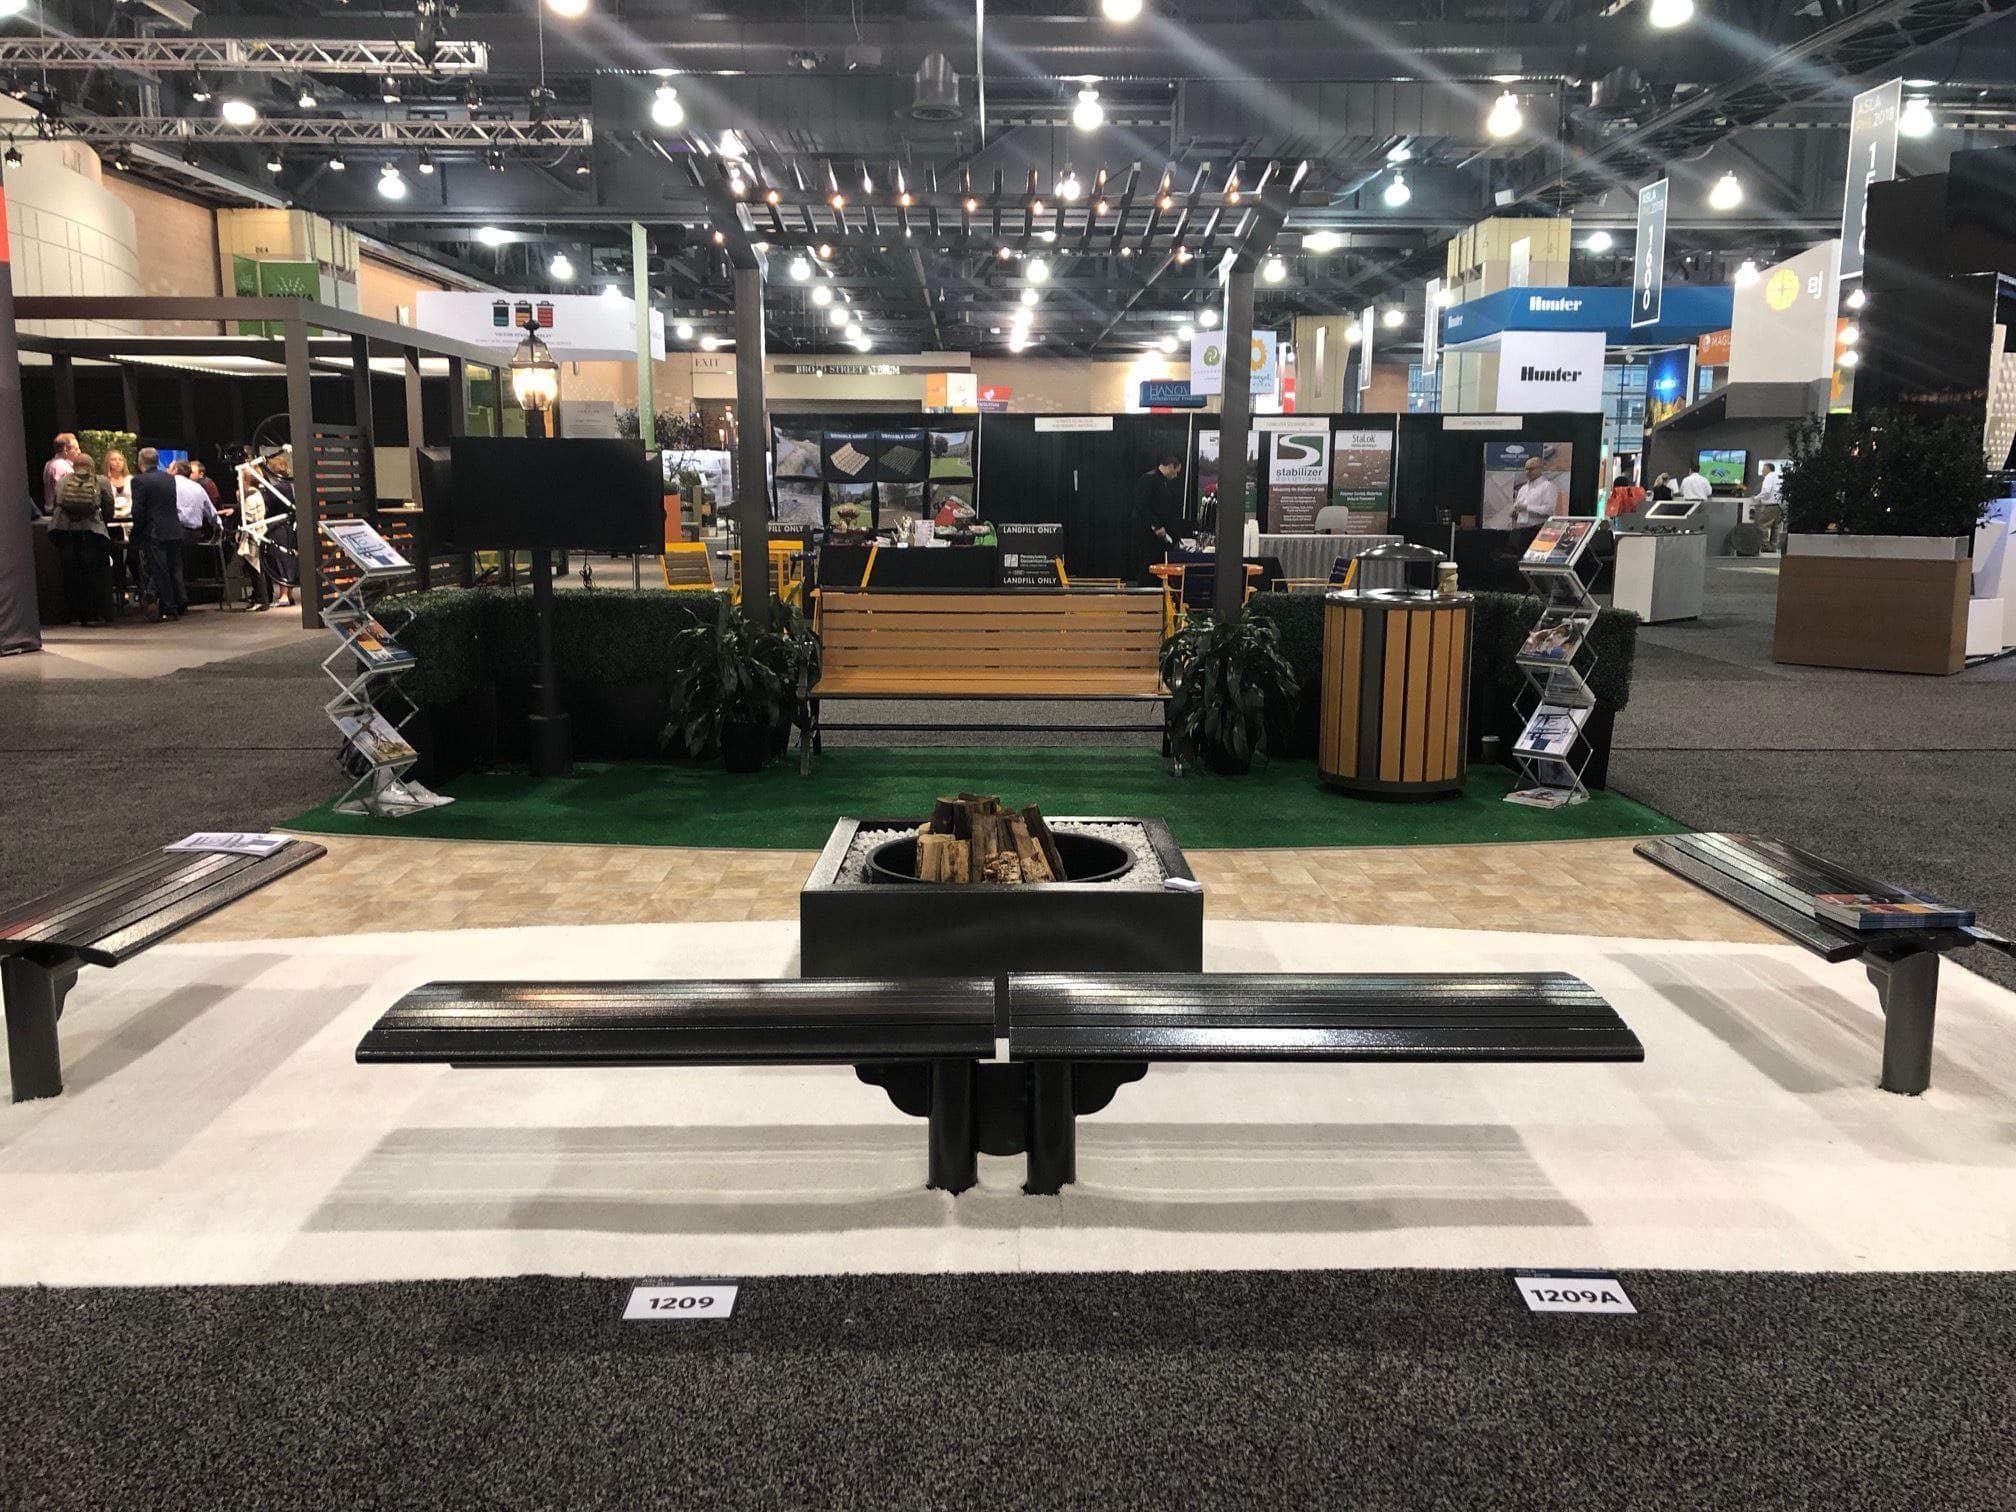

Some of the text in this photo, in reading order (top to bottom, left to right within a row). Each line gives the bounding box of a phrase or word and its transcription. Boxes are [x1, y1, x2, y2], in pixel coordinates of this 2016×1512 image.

[1643, 224, 1653, 311] 1600
[1529, 295, 1583, 312] Hunter
[695, 358, 719, 367] EXIT
[829, 364, 864, 375] STREET
[1521, 366, 1582, 382] Hunter
[1276, 467, 1323, 477] stabilizer
[1003, 526, 1057, 534] LANDFILL ONLY
[648, 1296, 715, 1310] 1209
[1529, 1289, 1622, 1304] 1209A
